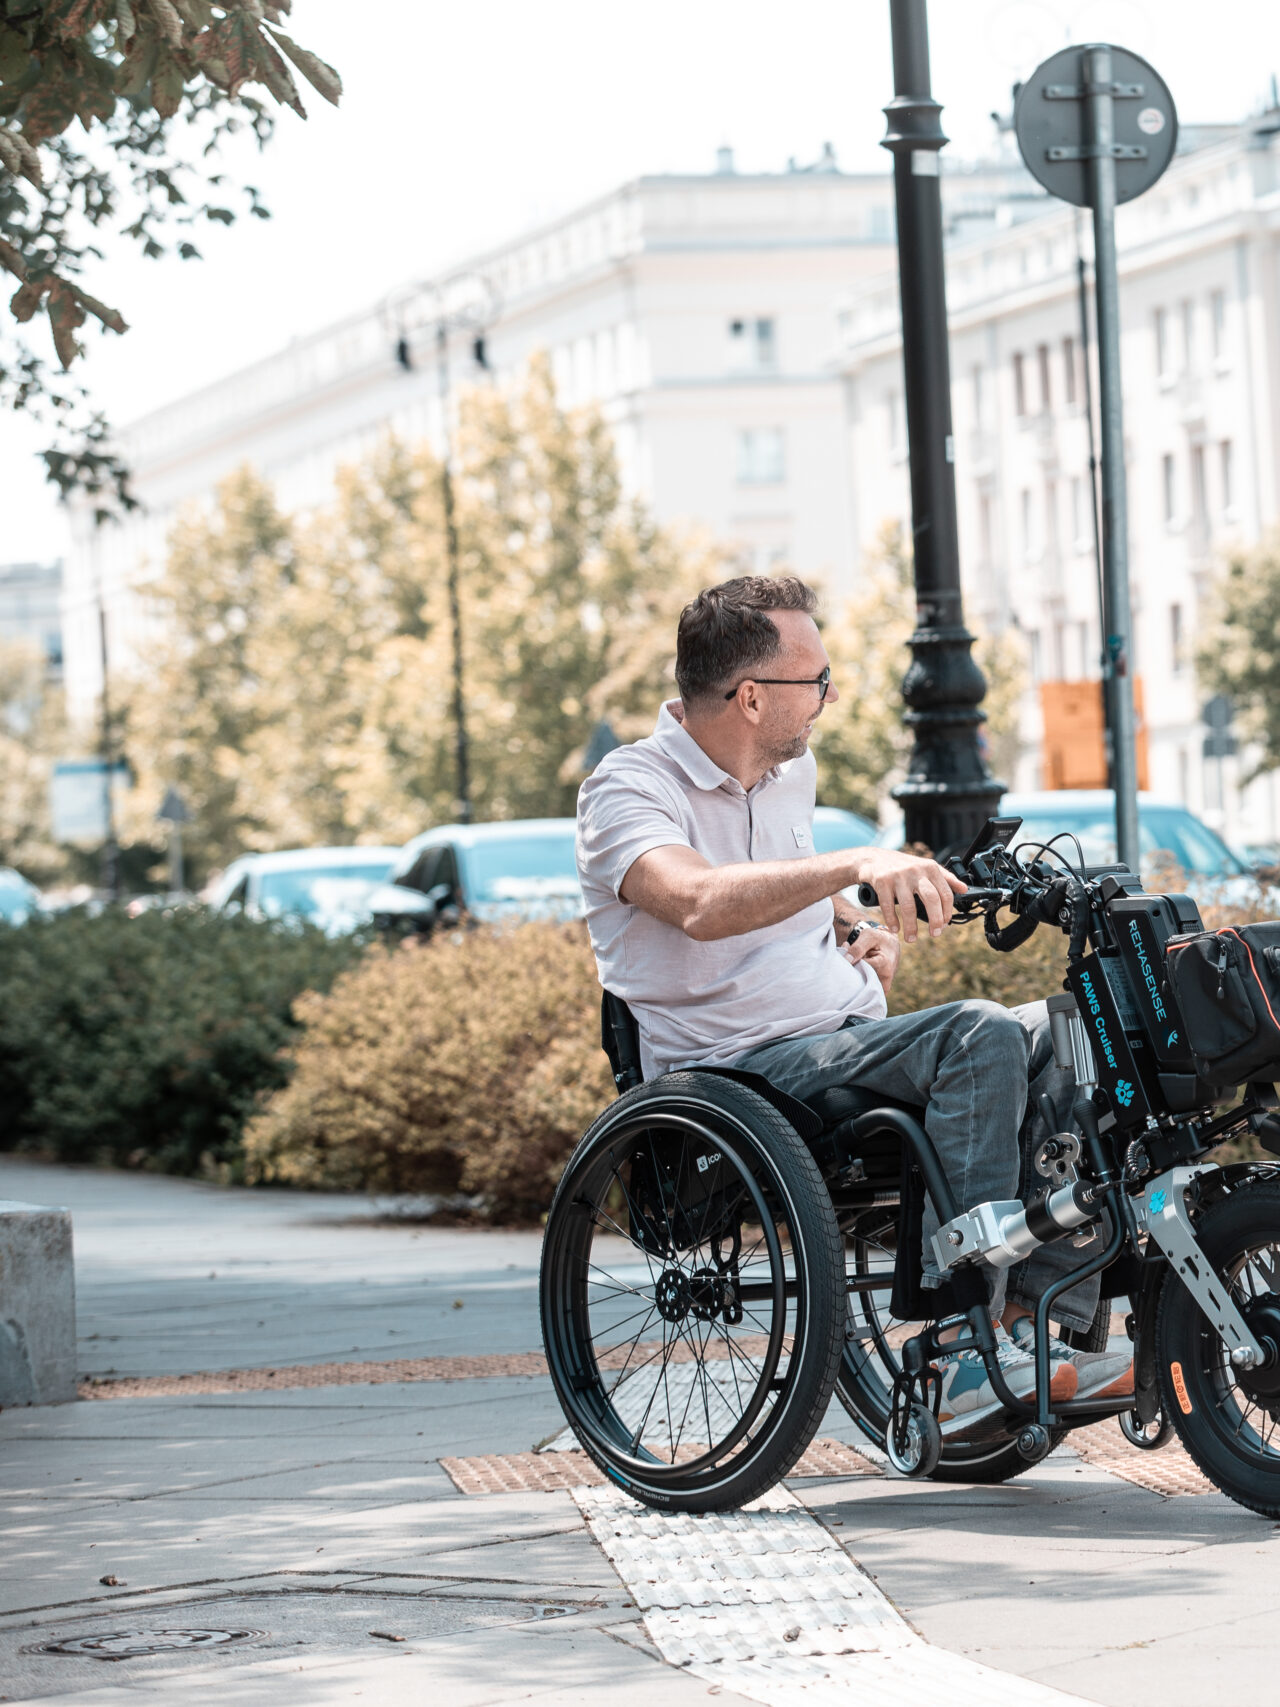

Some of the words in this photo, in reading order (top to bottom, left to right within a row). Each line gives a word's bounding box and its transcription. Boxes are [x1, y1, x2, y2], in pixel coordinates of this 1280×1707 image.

[1079, 971, 1101, 1016] PAWS
[1095, 1017, 1118, 1070] Cruiser
[1128, 919, 1167, 1023] REHASENSE
